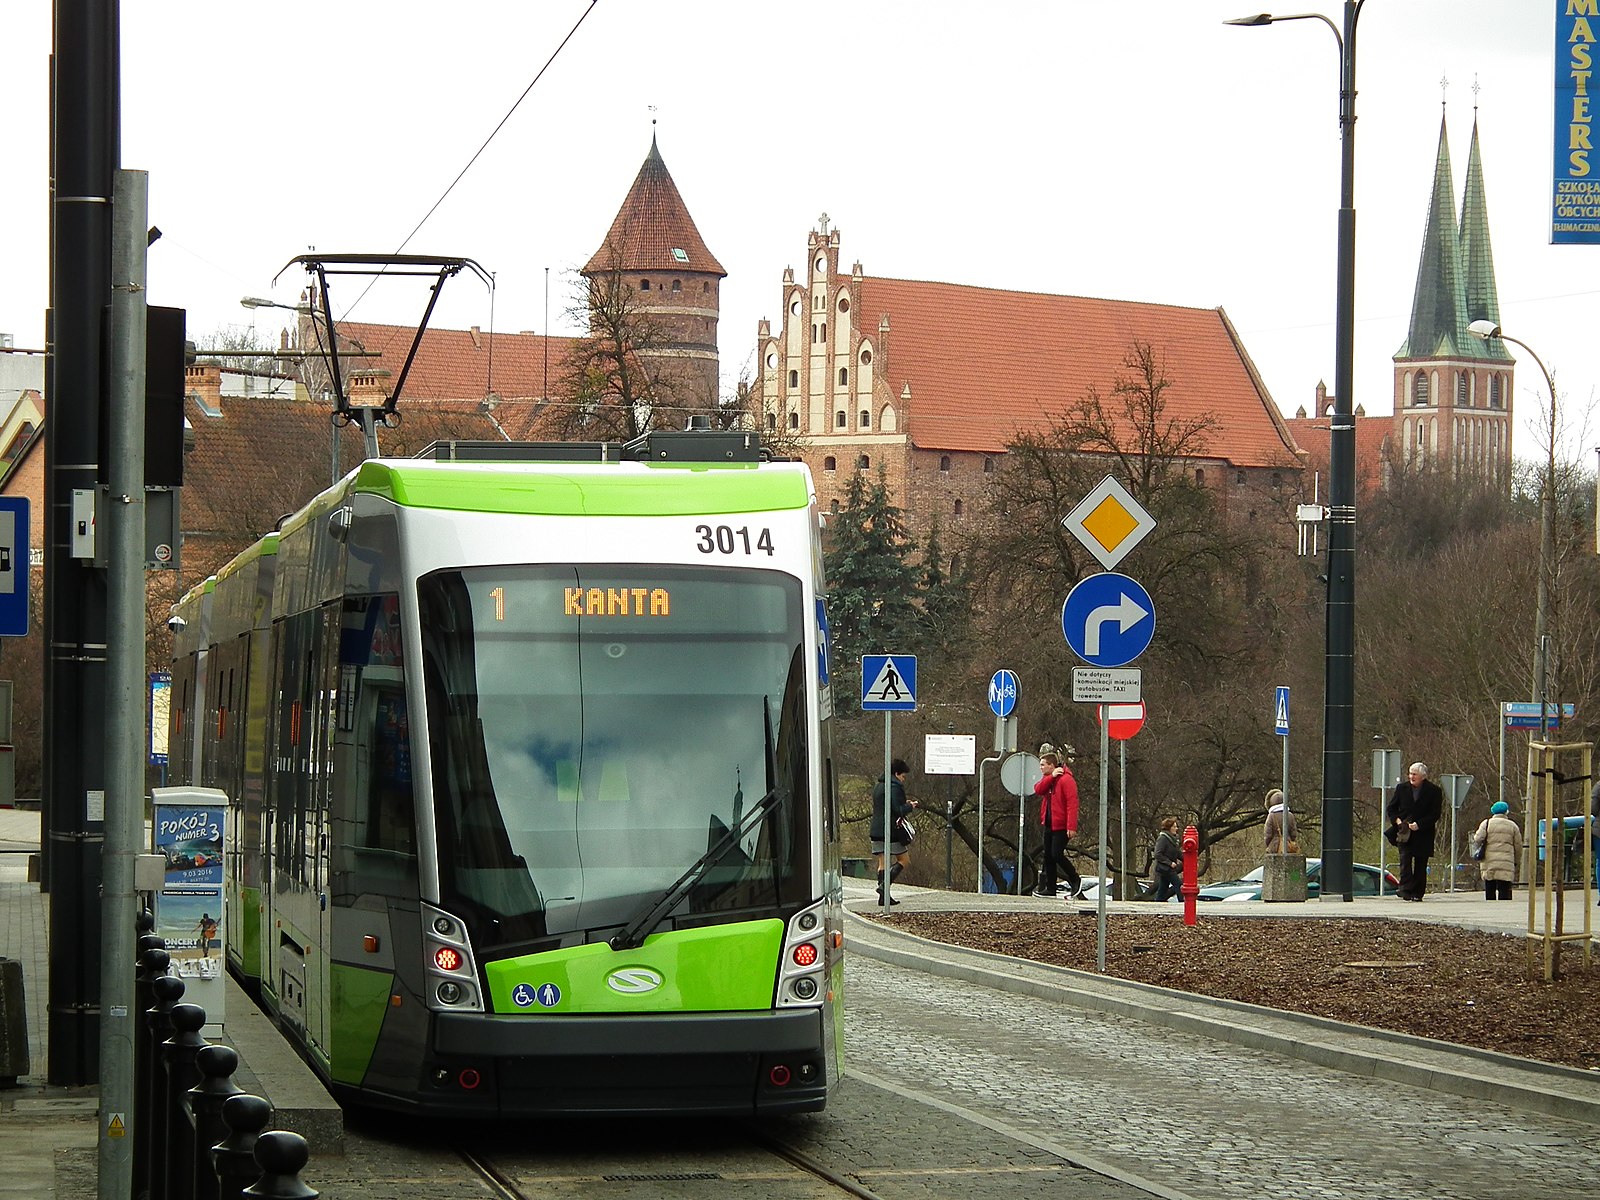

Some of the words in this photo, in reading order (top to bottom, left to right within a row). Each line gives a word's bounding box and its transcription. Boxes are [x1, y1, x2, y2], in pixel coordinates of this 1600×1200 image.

[1566, 0, 1600, 177] MASTERS
[1558, 181, 1600, 193] SZKOŁA
[695, 524, 775, 556] 3014
[488, 586, 505, 621] 1
[563, 587, 671, 616] KANTA
[160, 811, 208, 835] POKÓJ
[175, 827, 208, 841] NUMER
[208, 823, 220, 842] 3
[164, 937, 198, 946] ONCERT
